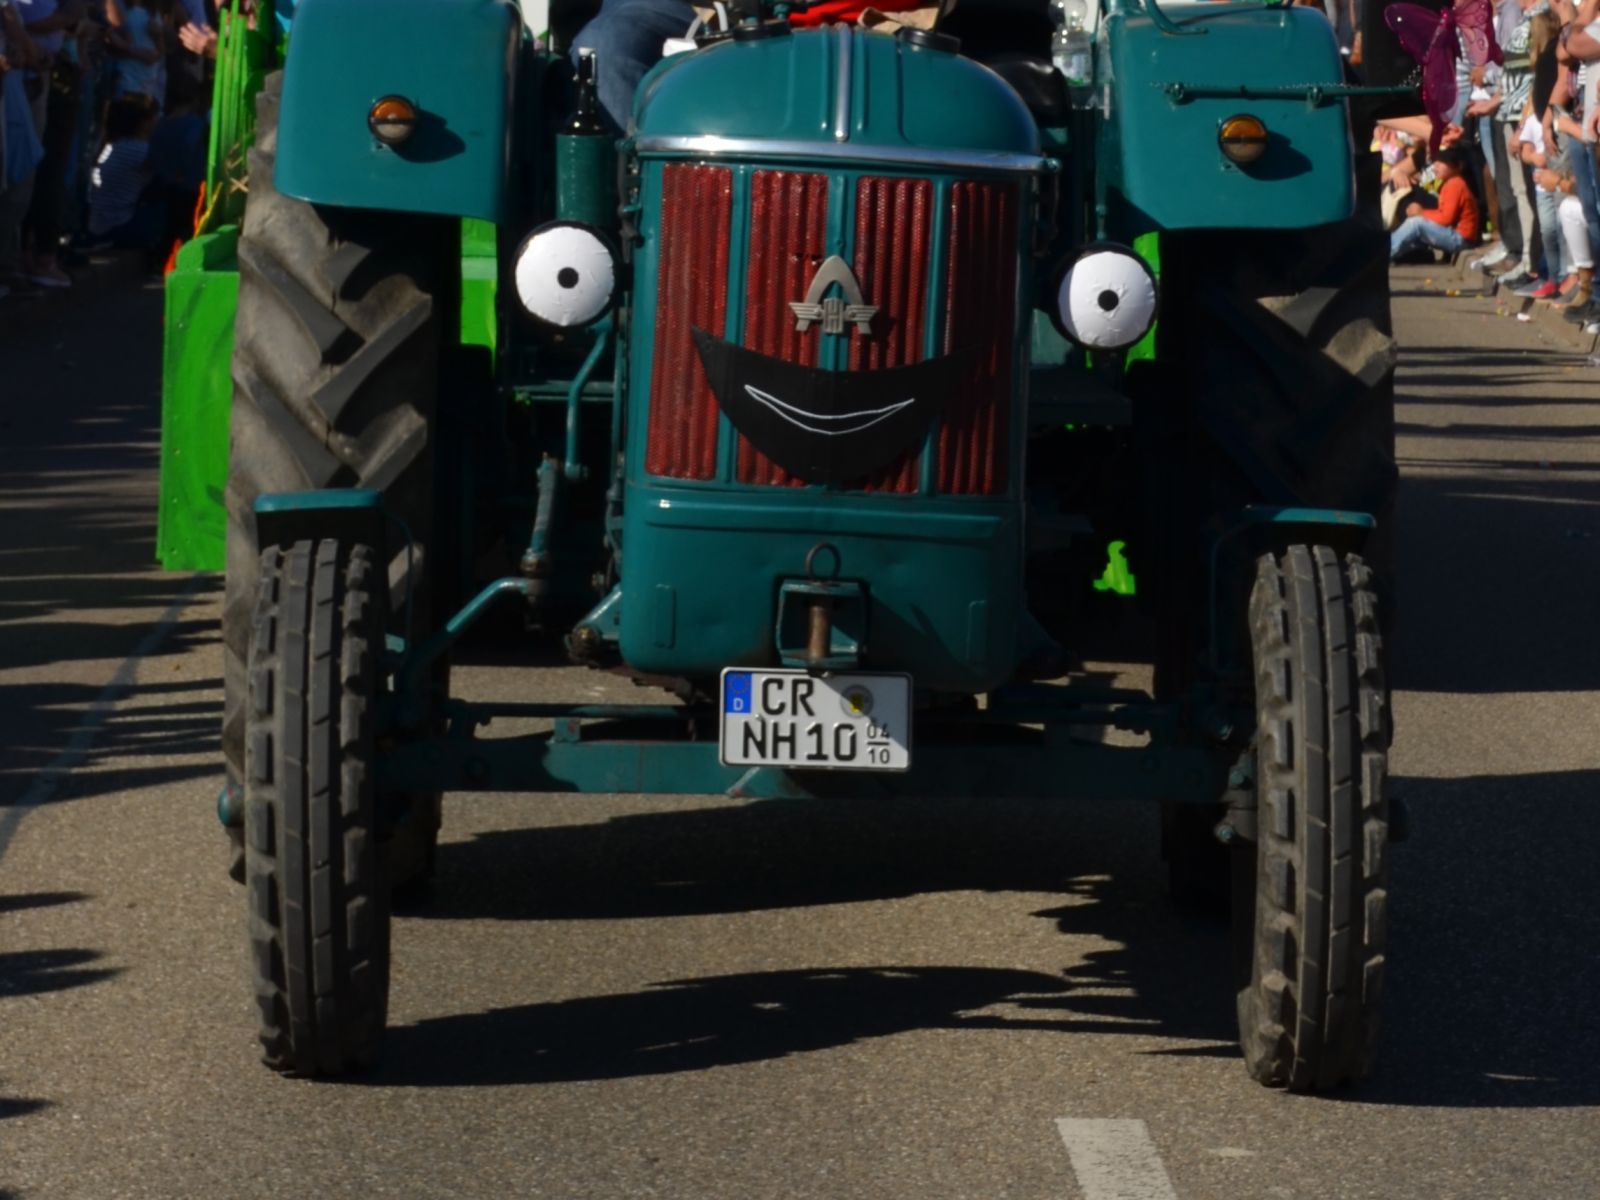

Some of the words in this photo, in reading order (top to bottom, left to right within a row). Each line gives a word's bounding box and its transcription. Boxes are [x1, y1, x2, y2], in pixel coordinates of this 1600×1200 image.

[733, 698, 744, 711] D
[762, 677, 815, 717] CR
[868, 748, 890, 765] 10
